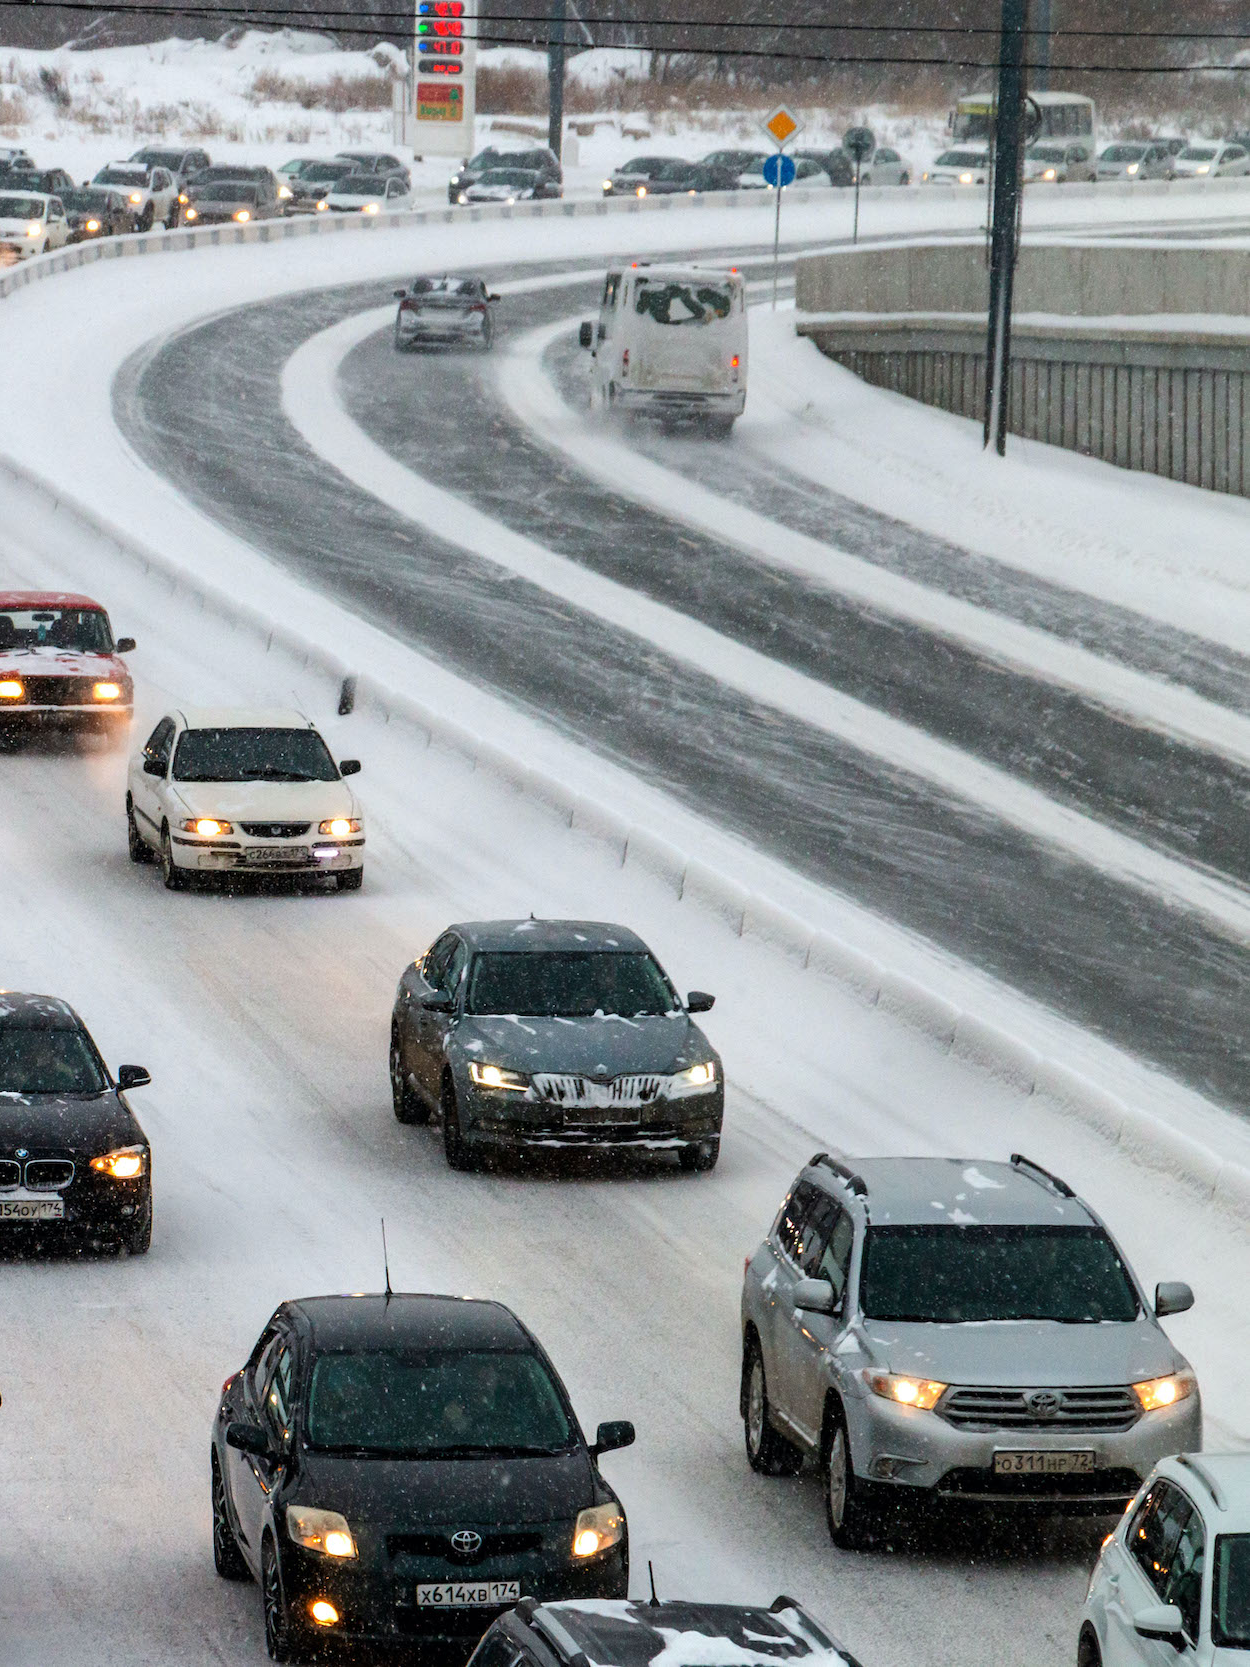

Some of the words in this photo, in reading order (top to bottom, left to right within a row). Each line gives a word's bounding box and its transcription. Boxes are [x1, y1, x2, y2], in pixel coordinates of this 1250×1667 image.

[41, 1203, 61, 1212] 174
[1001, 1455, 1067, 1470] О311НР
[1072, 1454, 1088, 1466] 72
[421, 1586, 487, 1603] Х614ХВ
[492, 1583, 517, 1596] 174
